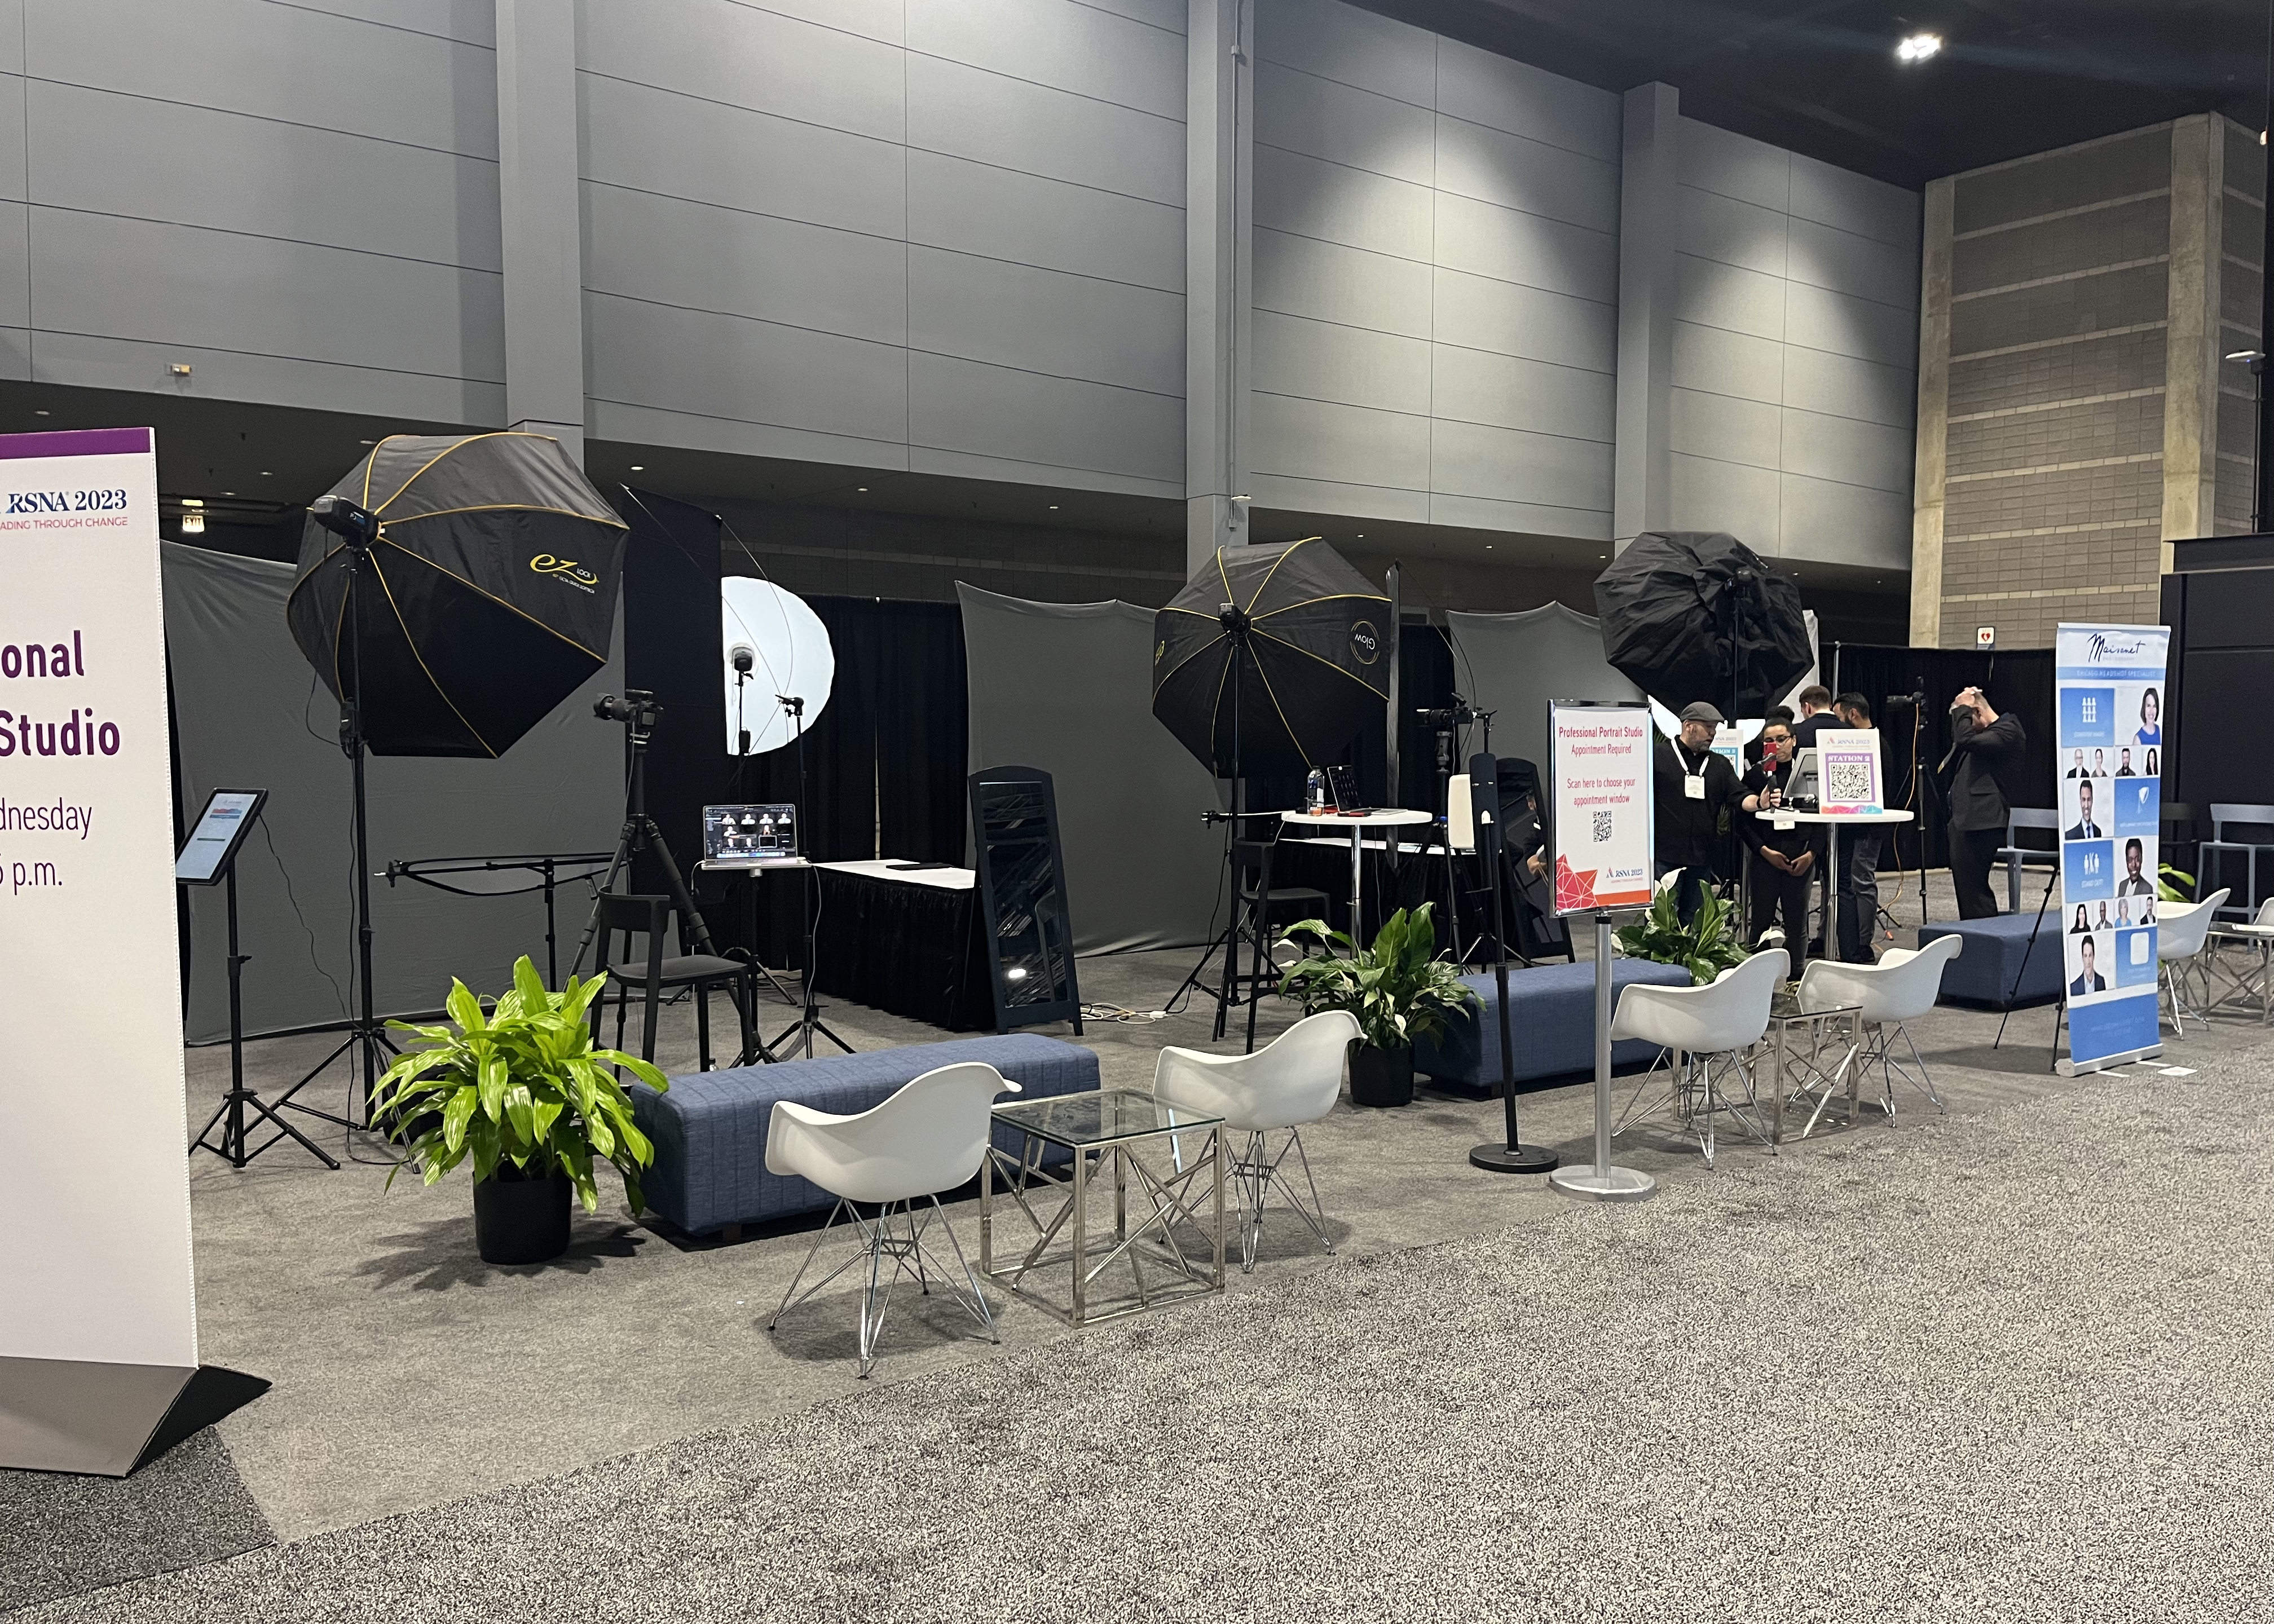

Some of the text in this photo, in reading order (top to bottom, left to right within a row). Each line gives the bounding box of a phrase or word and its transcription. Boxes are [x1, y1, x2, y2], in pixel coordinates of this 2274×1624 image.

[74, 489, 127, 511] 2023
[33, 518, 83, 529] THROUGH
[85, 517, 129, 527] CHANGE
[1355, 633, 1375, 650] Glow
[1559, 726, 1643, 738] Professional Portrait Studio
[1571, 743, 1632, 758] Appointment Required
[1567, 777, 1636, 789] Scan here to choose your
[1574, 793, 1630, 809] appointment window
[13, 862, 63, 896] p.m.
